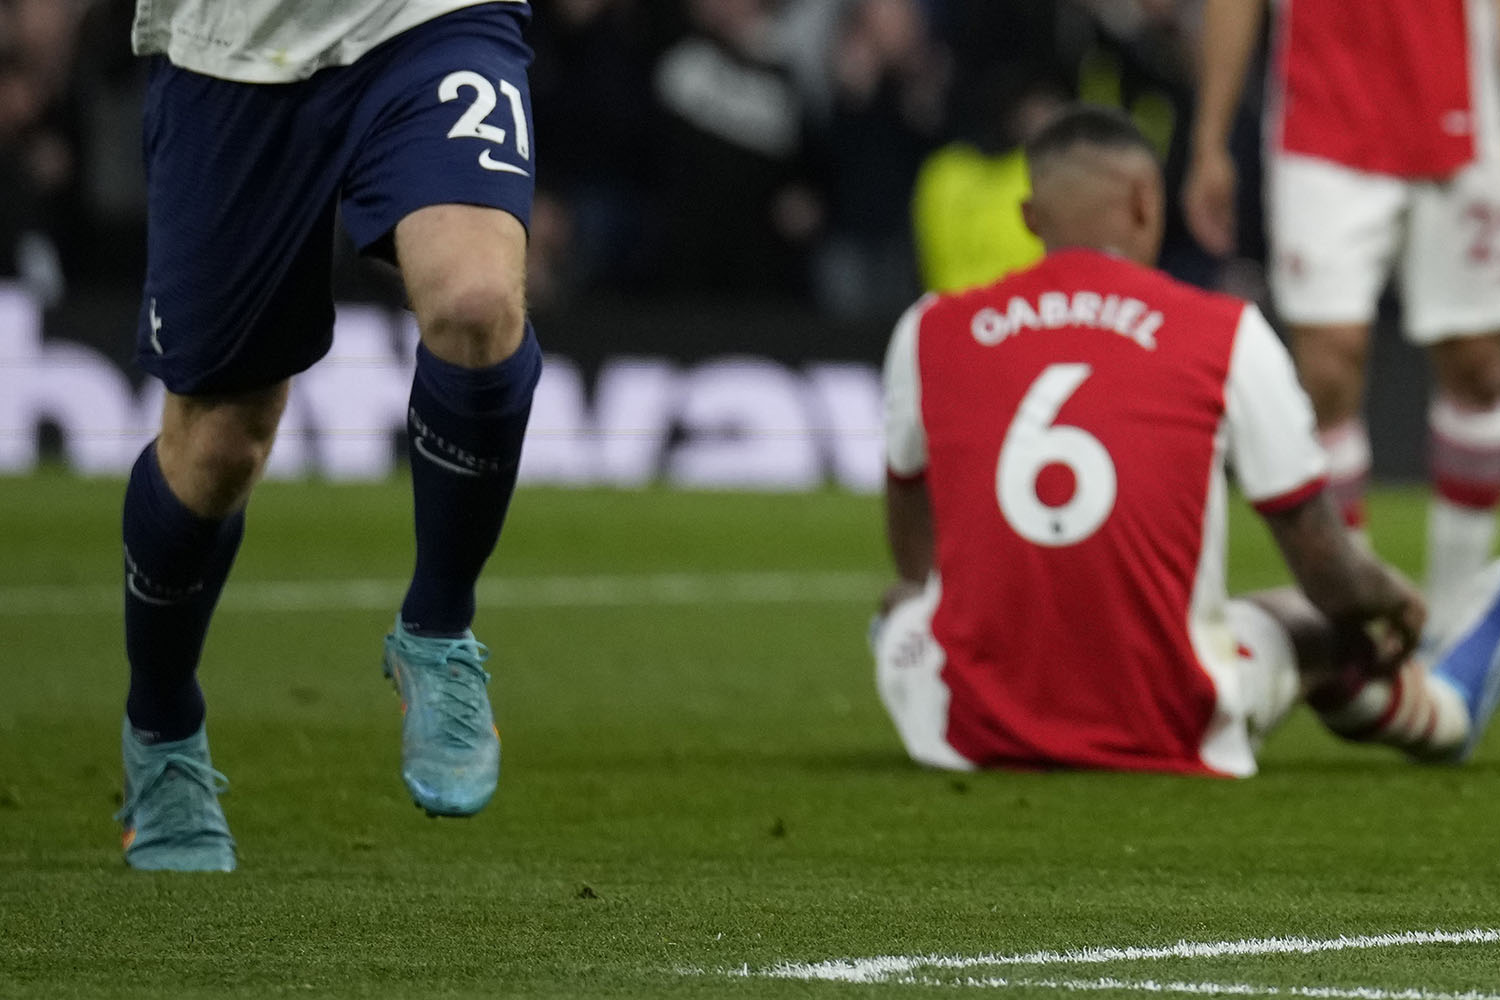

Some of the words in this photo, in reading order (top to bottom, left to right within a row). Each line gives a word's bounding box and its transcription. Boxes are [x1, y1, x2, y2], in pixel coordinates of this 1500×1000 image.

[438, 70, 529, 160] 21
[970, 291, 1163, 351] GABRIEL
[995, 362, 1117, 547] 6
